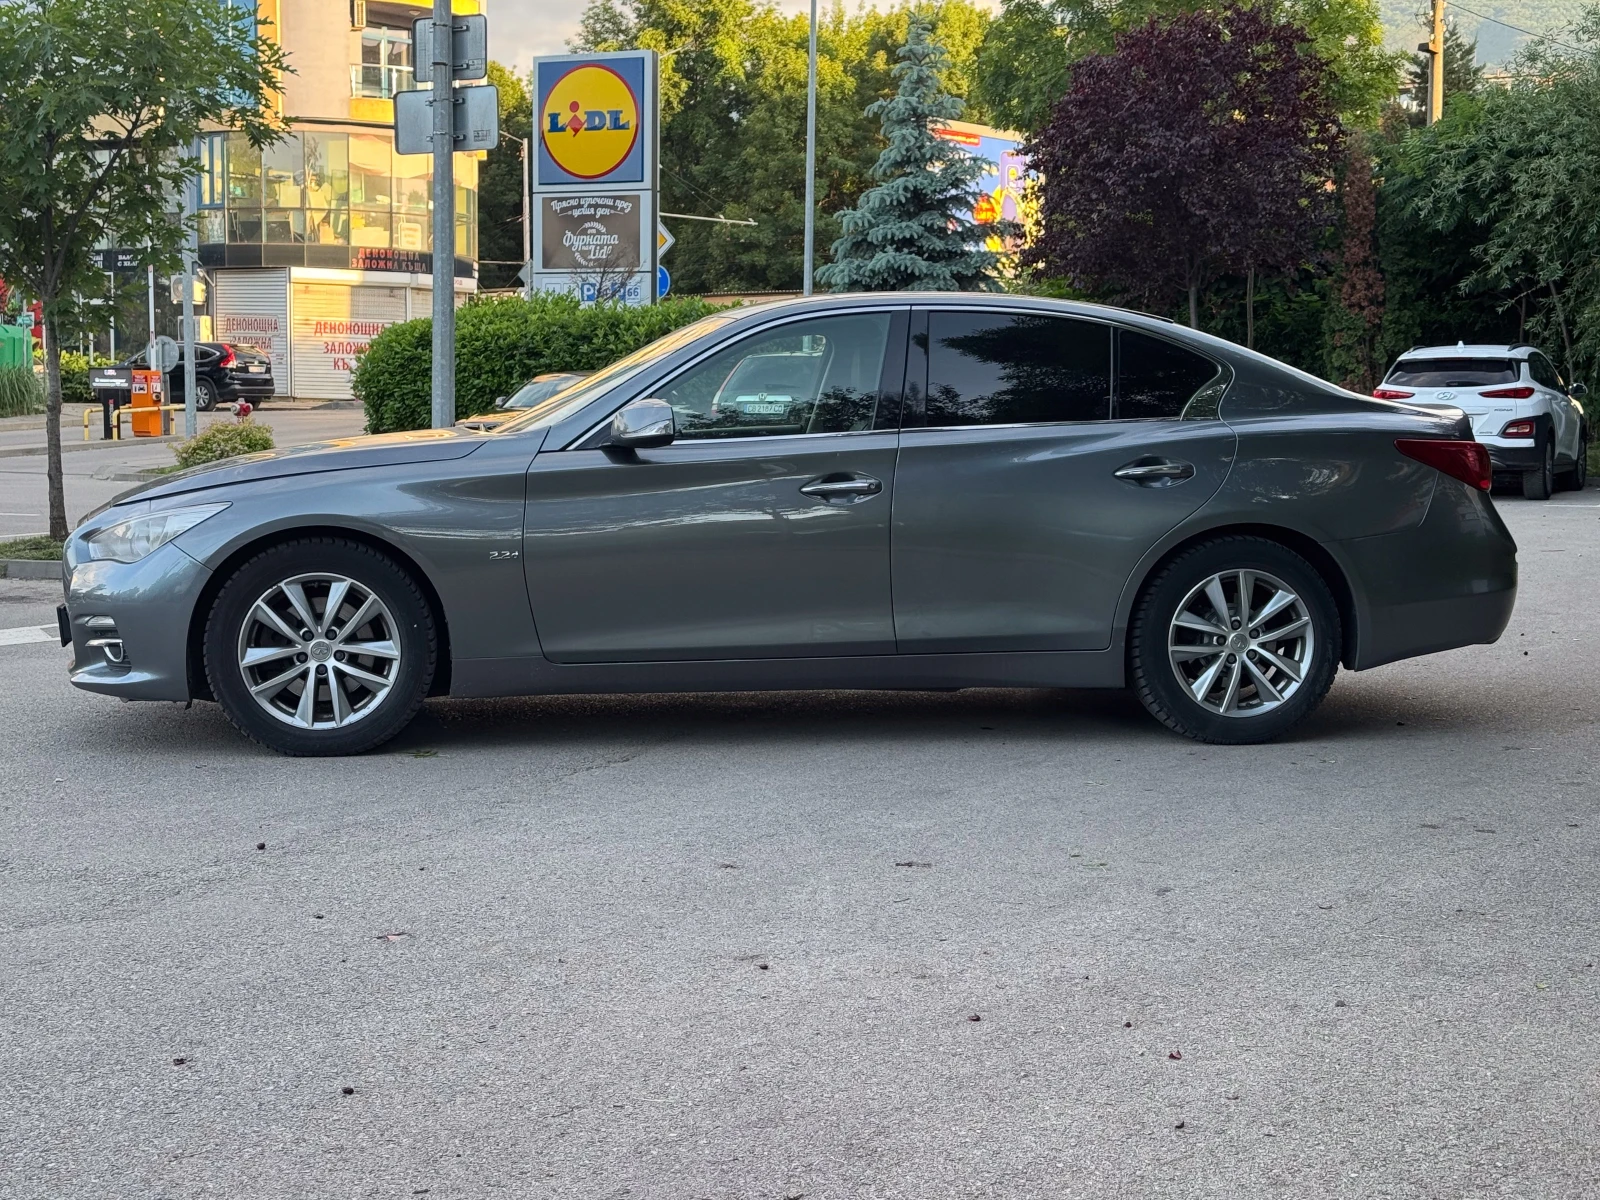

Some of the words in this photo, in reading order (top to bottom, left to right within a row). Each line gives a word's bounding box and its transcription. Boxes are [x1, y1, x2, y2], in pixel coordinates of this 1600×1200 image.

[550, 198, 579, 213] Прясно
[580, 197, 614, 208] изпечени
[614, 199, 633, 213] през
[596, 207, 610, 218] ден
[563, 230, 619, 251] Фурната
[358, 247, 419, 261] ДЕНОНОЩНА
[588, 245, 612, 258] Lidl
[351, 258, 399, 270] ЗАЛОЖНА
[402, 262, 427, 273] КЪЩА
[626, 287, 640, 297] 66
[225, 318, 279, 335] ДЕНОНОЩНА
